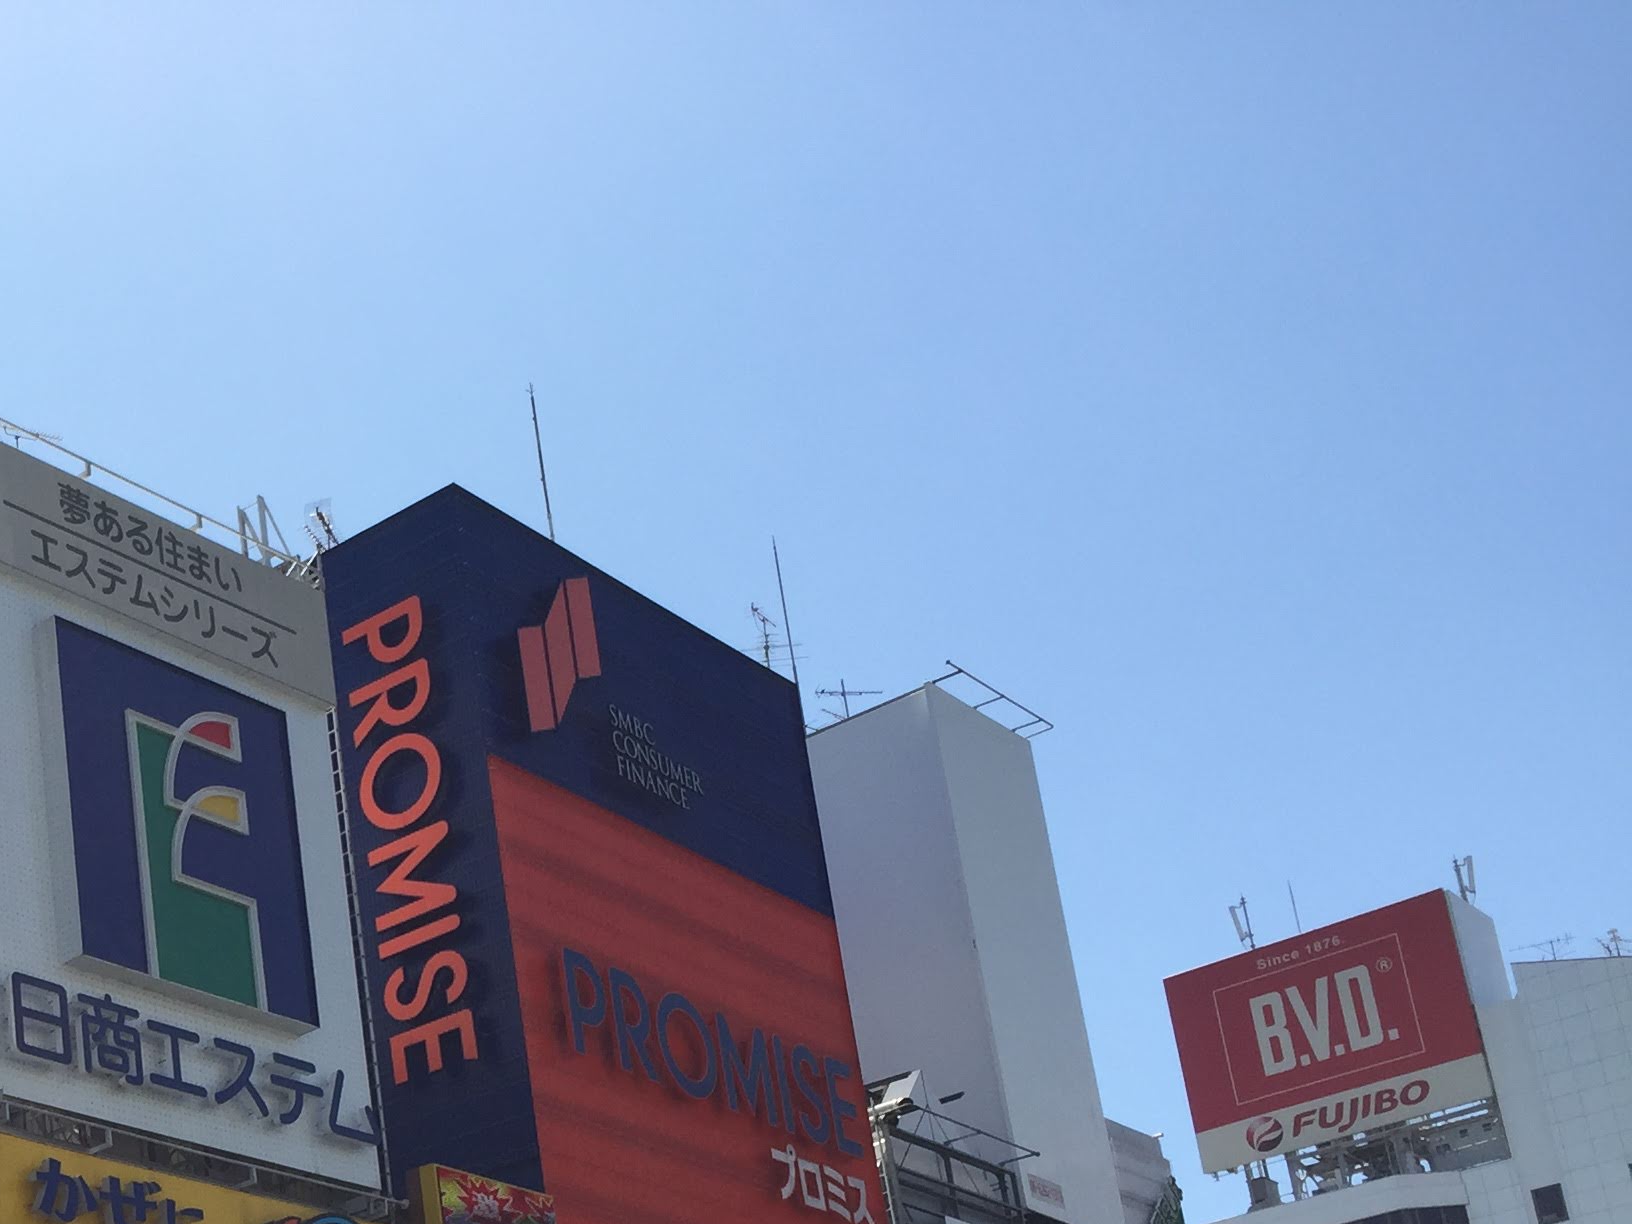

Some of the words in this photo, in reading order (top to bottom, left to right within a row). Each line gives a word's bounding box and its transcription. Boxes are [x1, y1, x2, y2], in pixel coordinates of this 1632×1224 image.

[58, 482, 243, 592] 夢ある住まい
[30, 529, 279, 668] エステムシリーズ
[609, 704, 656, 746] SMBC
[613, 730, 704, 795] CONSUMER
[617, 754, 690, 810] FINANCE
[341, 595, 478, 1085] PROMISE
[1256, 949, 1300, 971] Since
[1304, 934, 1342, 956] 1876
[11, 971, 381, 1146] 日商エステム
[562, 948, 864, 1160] PROMISE
[1249, 964, 1400, 1077] B.V.D.
[1291, 1078, 1431, 1138] FUJIBO
